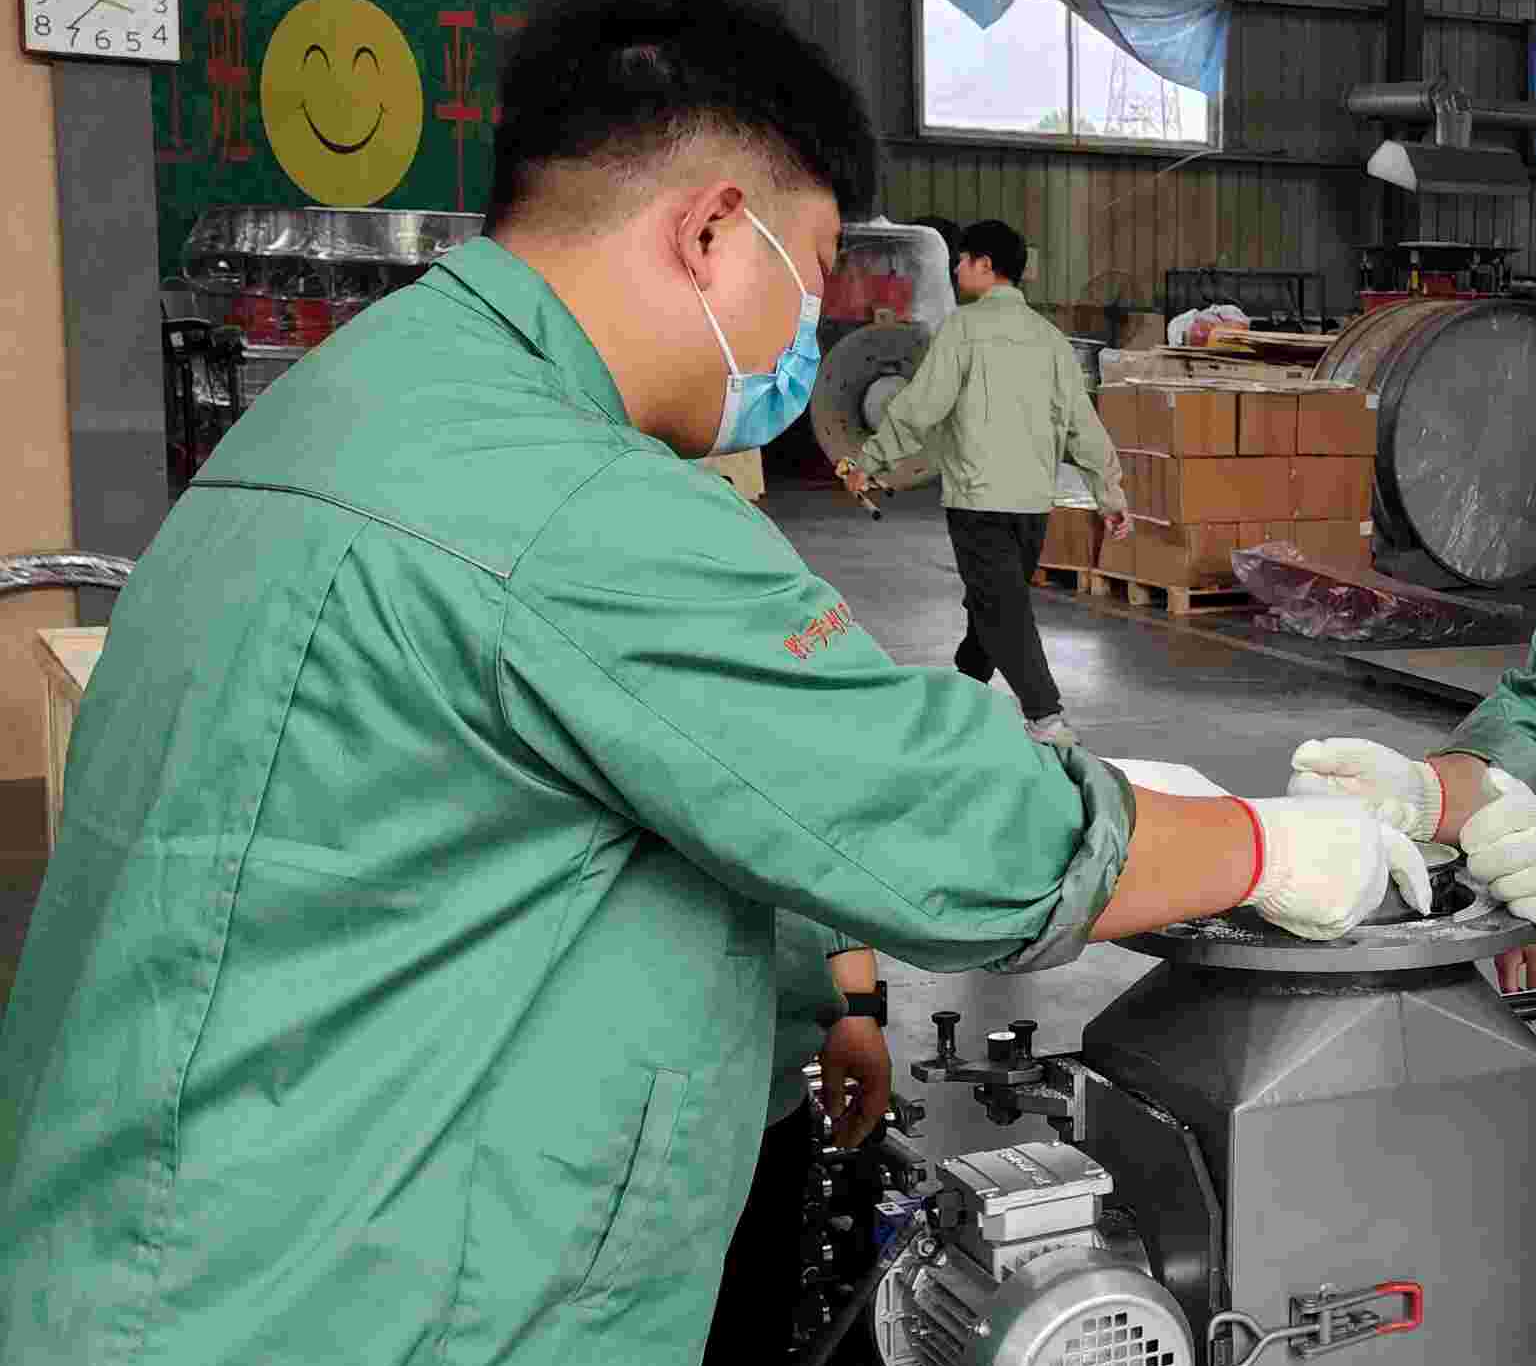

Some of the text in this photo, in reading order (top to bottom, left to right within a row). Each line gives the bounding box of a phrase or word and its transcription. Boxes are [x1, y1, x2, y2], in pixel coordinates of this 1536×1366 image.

[34, 14, 52, 37] 8
[152, 24, 168, 45] 4
[67, 26, 142, 53] 7 6 5
